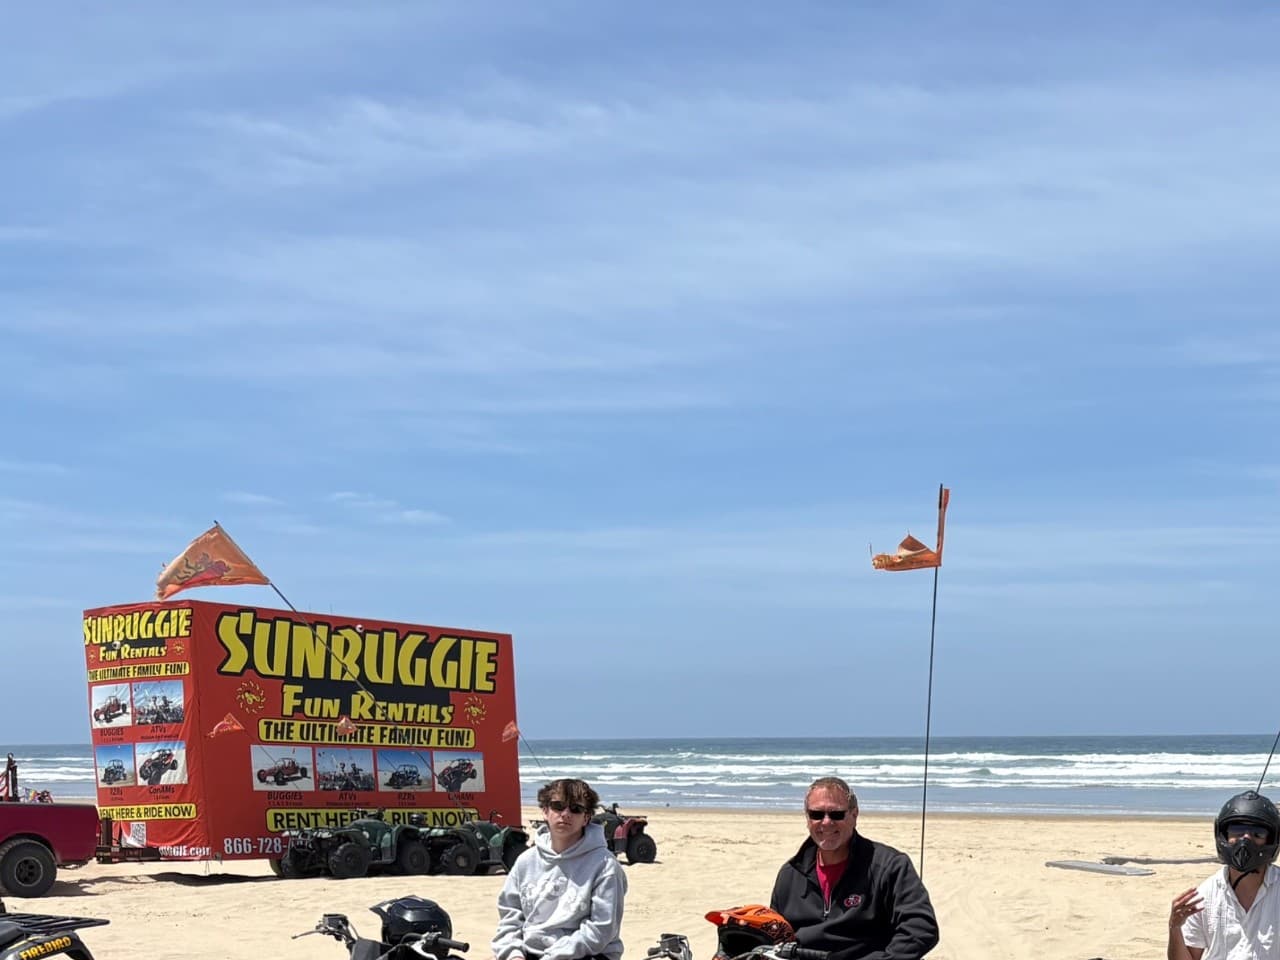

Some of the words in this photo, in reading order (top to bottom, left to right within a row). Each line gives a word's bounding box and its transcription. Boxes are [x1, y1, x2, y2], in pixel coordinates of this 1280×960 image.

[83, 609, 192, 645] SUNBUGGIE
[217, 611, 498, 692] SUNBUGGIE
[100, 666, 130, 679] ULTIMATE
[132, 664, 161, 677] FAMILY
[165, 662, 187, 675] FUN!
[281, 684, 341, 718] FUN
[350, 690, 454, 724] RENTALS
[263, 720, 294, 741] THE
[380, 725, 432, 745] FAMILY
[437, 729, 470, 746] FUN!
[267, 791, 303, 801] BUGGIES
[116, 807, 135, 819] HERE
[136, 807, 142, 818] &
[144, 806, 165, 818] RIDE
[165, 805, 193, 818] NOW
[273, 812, 321, 829] RENT
[326, 812, 368, 828] HER
[223, 837, 289, 855] 866-728-
[19, 936, 72, 960] FIREBIRD
